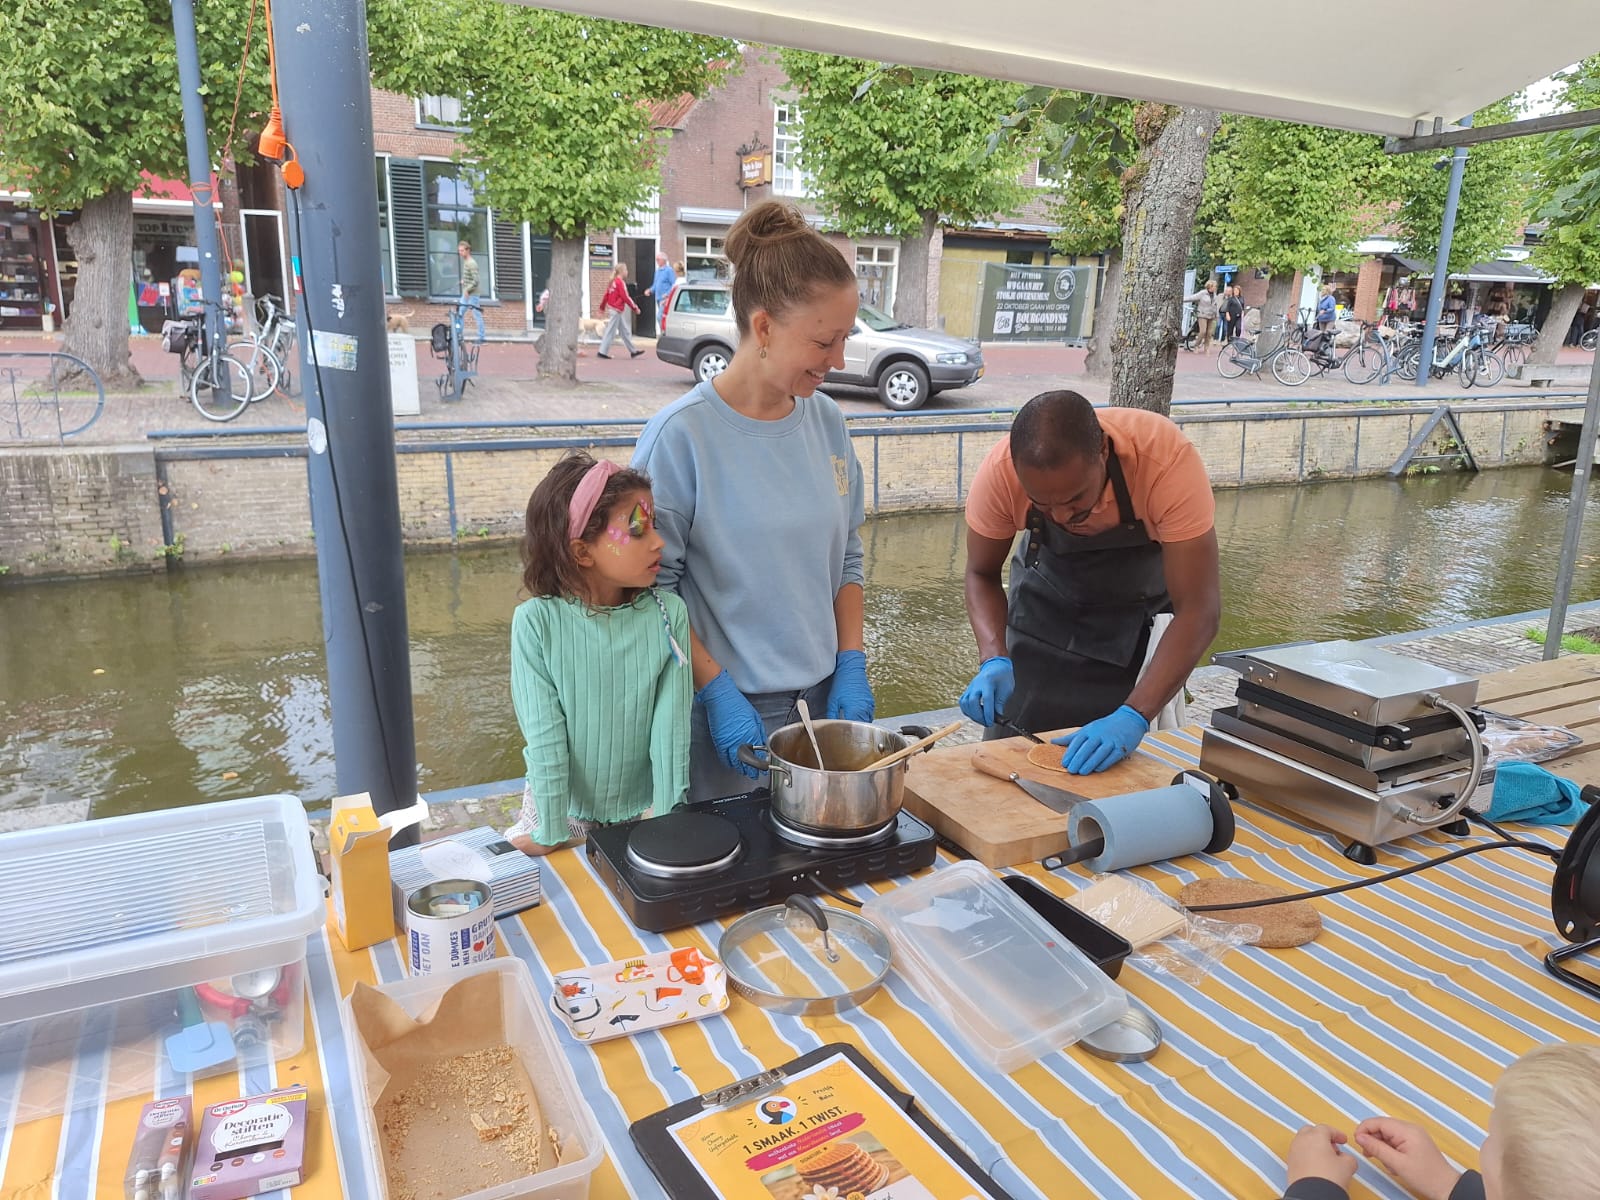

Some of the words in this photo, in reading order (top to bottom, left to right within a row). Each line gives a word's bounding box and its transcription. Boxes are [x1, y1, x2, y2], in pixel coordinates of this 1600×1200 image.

[224, 1113, 284, 1130] Decoratie
[231, 1122, 274, 1136] stiften
[743, 1145, 752, 1154] 1
[752, 1126, 800, 1151] SMAAK.
[799, 1121, 809, 1130] 1
[807, 1106, 848, 1126] TWIST.
